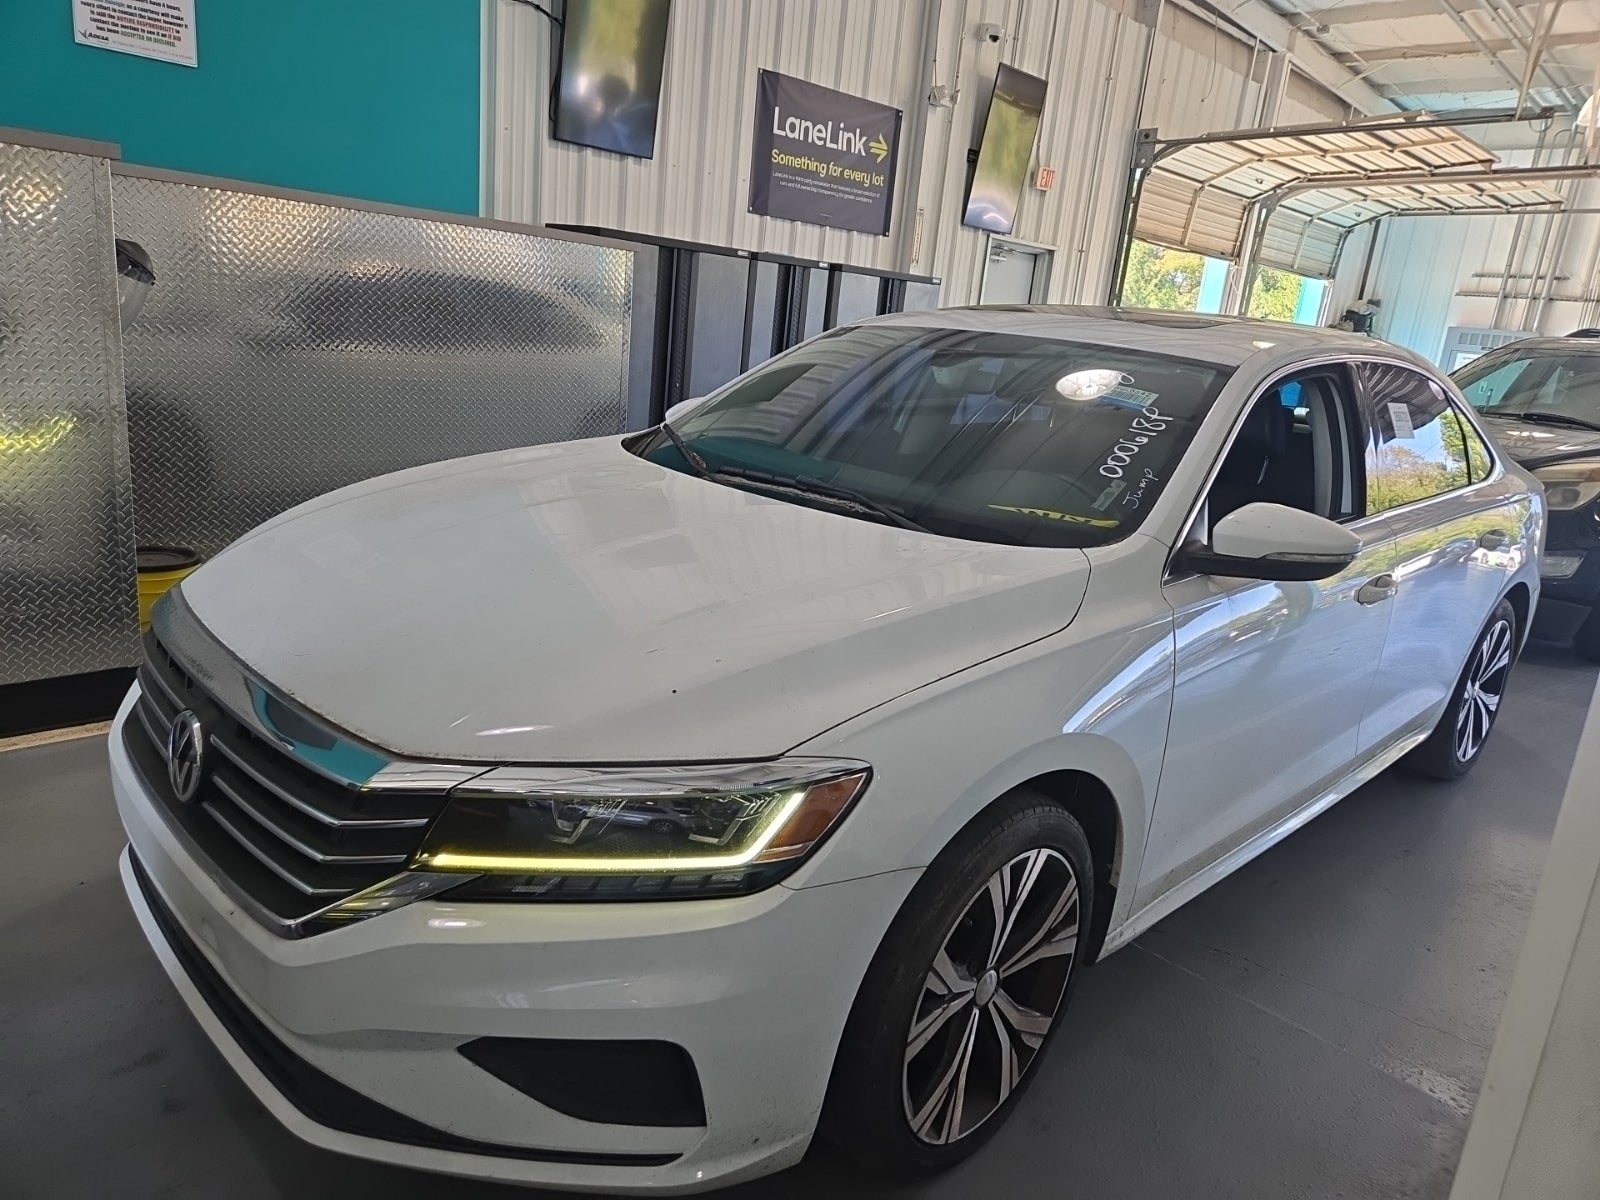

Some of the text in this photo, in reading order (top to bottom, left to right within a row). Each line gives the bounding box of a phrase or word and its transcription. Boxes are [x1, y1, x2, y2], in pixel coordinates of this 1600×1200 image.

[138, 6, 160, 16] courtesy
[88, 32, 109, 41] ADESA
[773, 106, 868, 156] LaneLink
[771, 149, 827, 177] Something
[829, 162, 843, 177] for
[844, 167, 871, 187] every
[872, 173, 884, 186] lot
[1040, 168, 1055, 189] EXIT
[1123, 468, 1159, 509] Jump
